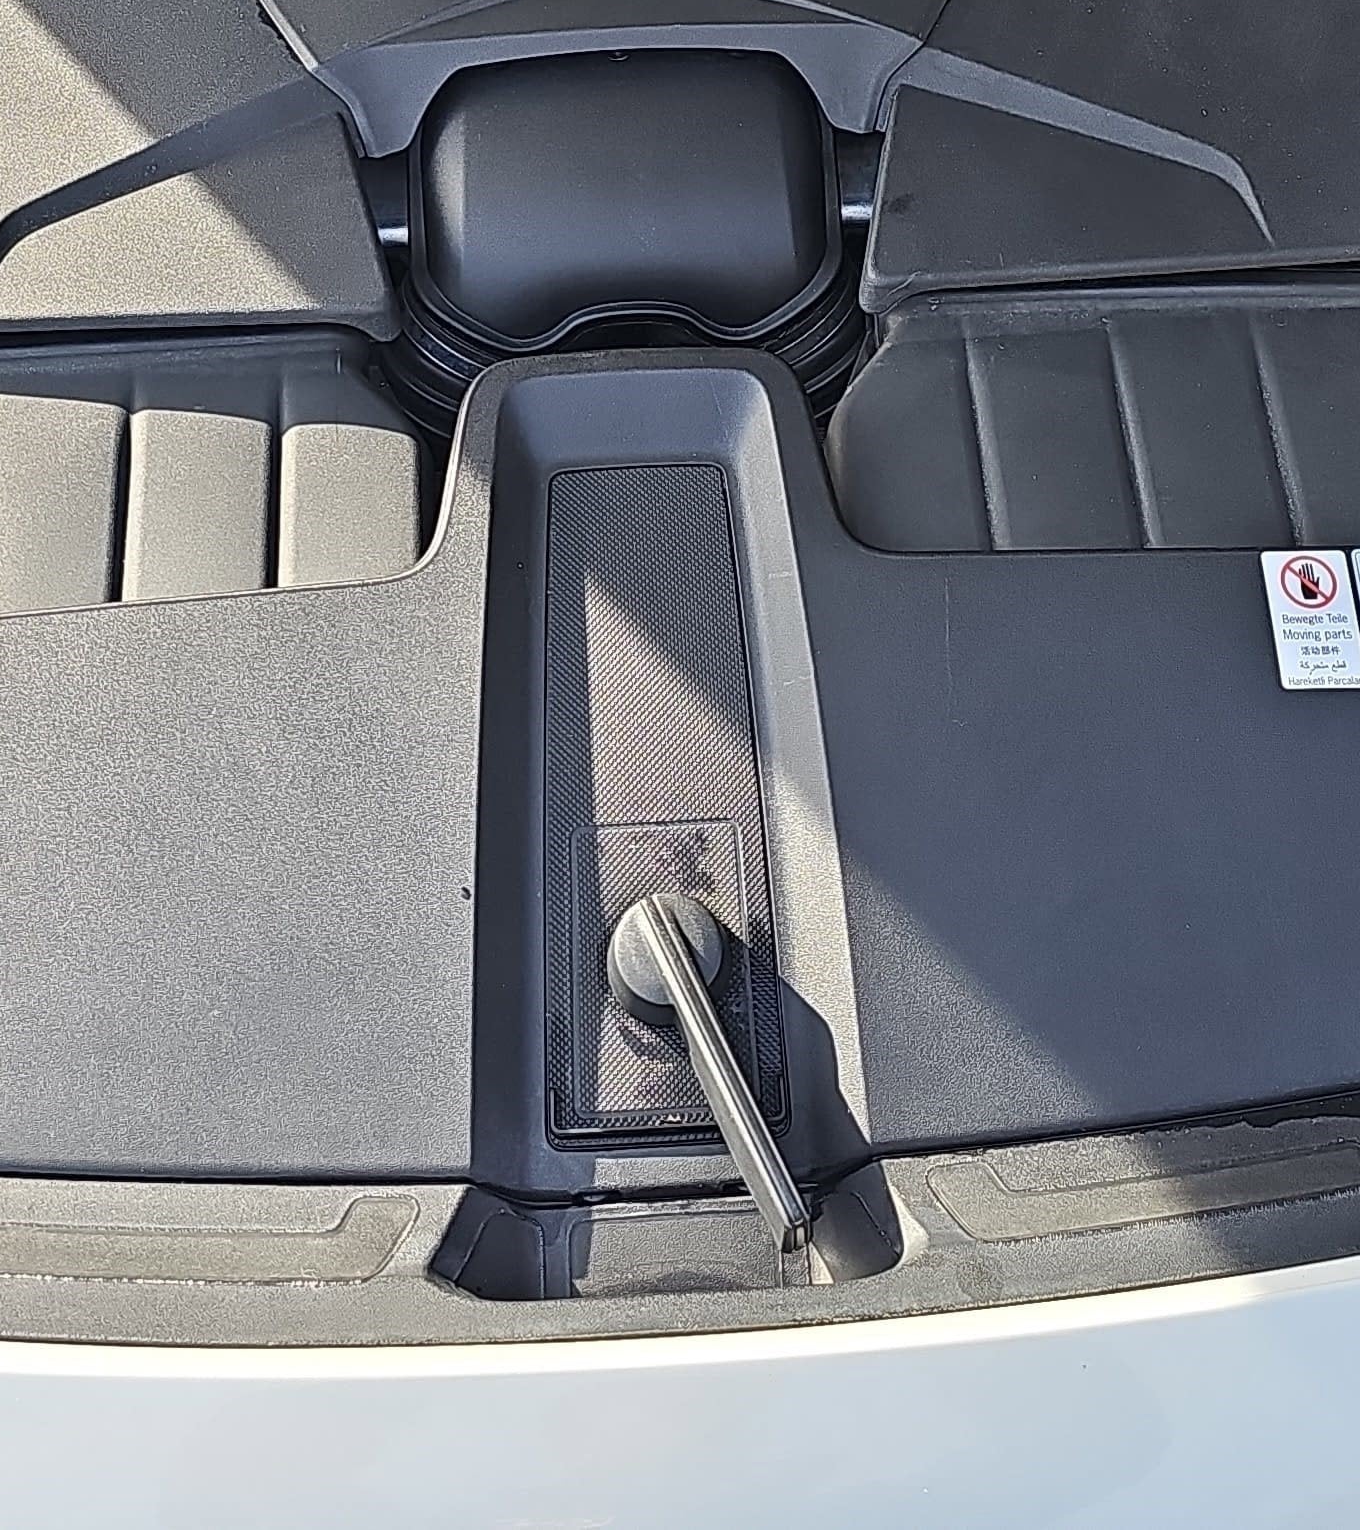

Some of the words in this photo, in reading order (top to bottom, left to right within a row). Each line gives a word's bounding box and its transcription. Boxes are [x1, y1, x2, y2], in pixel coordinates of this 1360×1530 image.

[1282, 613, 1324, 626] Bewegte
[1326, 613, 1349, 624] Teile
[1282, 628, 1322, 642] Moving
[1324, 628, 1353, 642] parts
